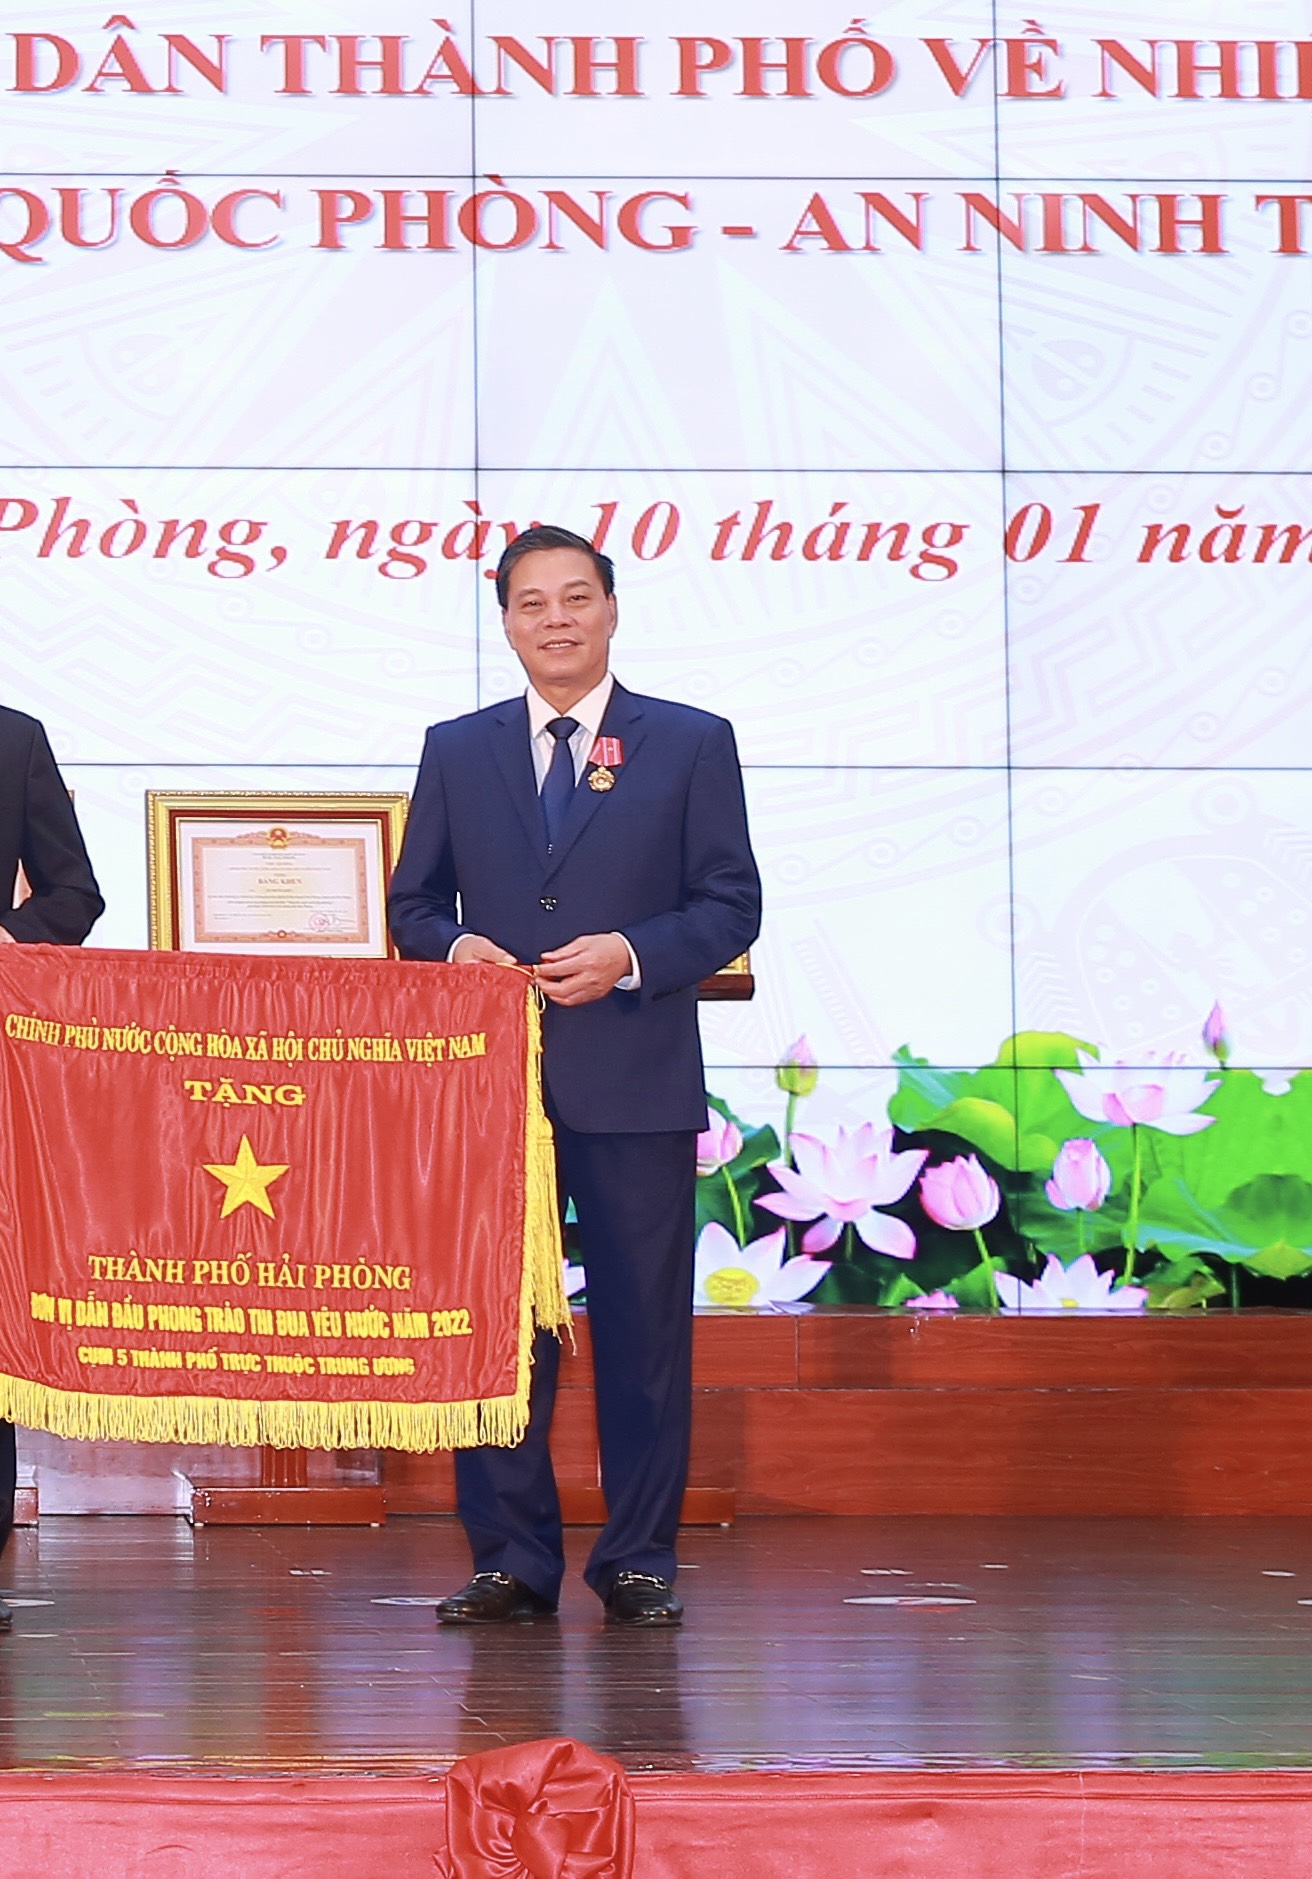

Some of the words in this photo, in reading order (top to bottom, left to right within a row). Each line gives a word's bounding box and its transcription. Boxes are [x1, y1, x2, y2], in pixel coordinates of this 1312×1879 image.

[9, 15, 228, 92] DÂN
[256, 20, 644, 95] THÀNH
[672, 19, 898, 96] PHỐ
[919, 20, 1065, 97] VỀ
[312, 175, 696, 250] PHÒNG
[723, 225, 752, 236] -
[779, 192, 926, 250] AN
[956, 193, 1227, 253] NINH
[591, 501, 680, 561] 10
[712, 500, 966, 578] tháng
[1005, 504, 1100, 562] 01
[1139, 507, 1312, 563] năm
[5, 1012, 61, 1046] CHÍNH
[65, 1017, 99, 1049] PHỦ
[103, 1022, 151, 1054] NƯỚC
[154, 1025, 202, 1062] CỘNG
[207, 1029, 242, 1058] HÒA
[246, 1031, 268, 1060] XÃ
[272, 1031, 303, 1067] HỘI
[308, 1028, 344, 1060] CHỦ
[347, 1032, 402, 1061] NGHĨA
[405, 1031, 445, 1067] VIỆT
[449, 1033, 485, 1059] NAM
[185, 1078, 306, 1107] TẶNG
[88, 1251, 185, 1284] THÀNH
[193, 1253, 251, 1285] PHỐ
[257, 1254, 306, 1288] HẢI
[315, 1258, 410, 1289] PHÒNG
[148, 1305, 202, 1332] PHONG
[205, 1302, 245, 1333] TRÀO
[248, 1309, 275, 1335] THI
[276, 1309, 309, 1336] ĐUA
[312, 1305, 341, 1337] YÊU
[432, 1309, 472, 1336] 2022
[117, 1349, 127, 1365] 5
[130, 1347, 182, 1368] THÀNH
[186, 1347, 217, 1369] PHỐ
[220, 1353, 261, 1374] TRỰC
[318, 1357, 369, 1375] TRUNG
